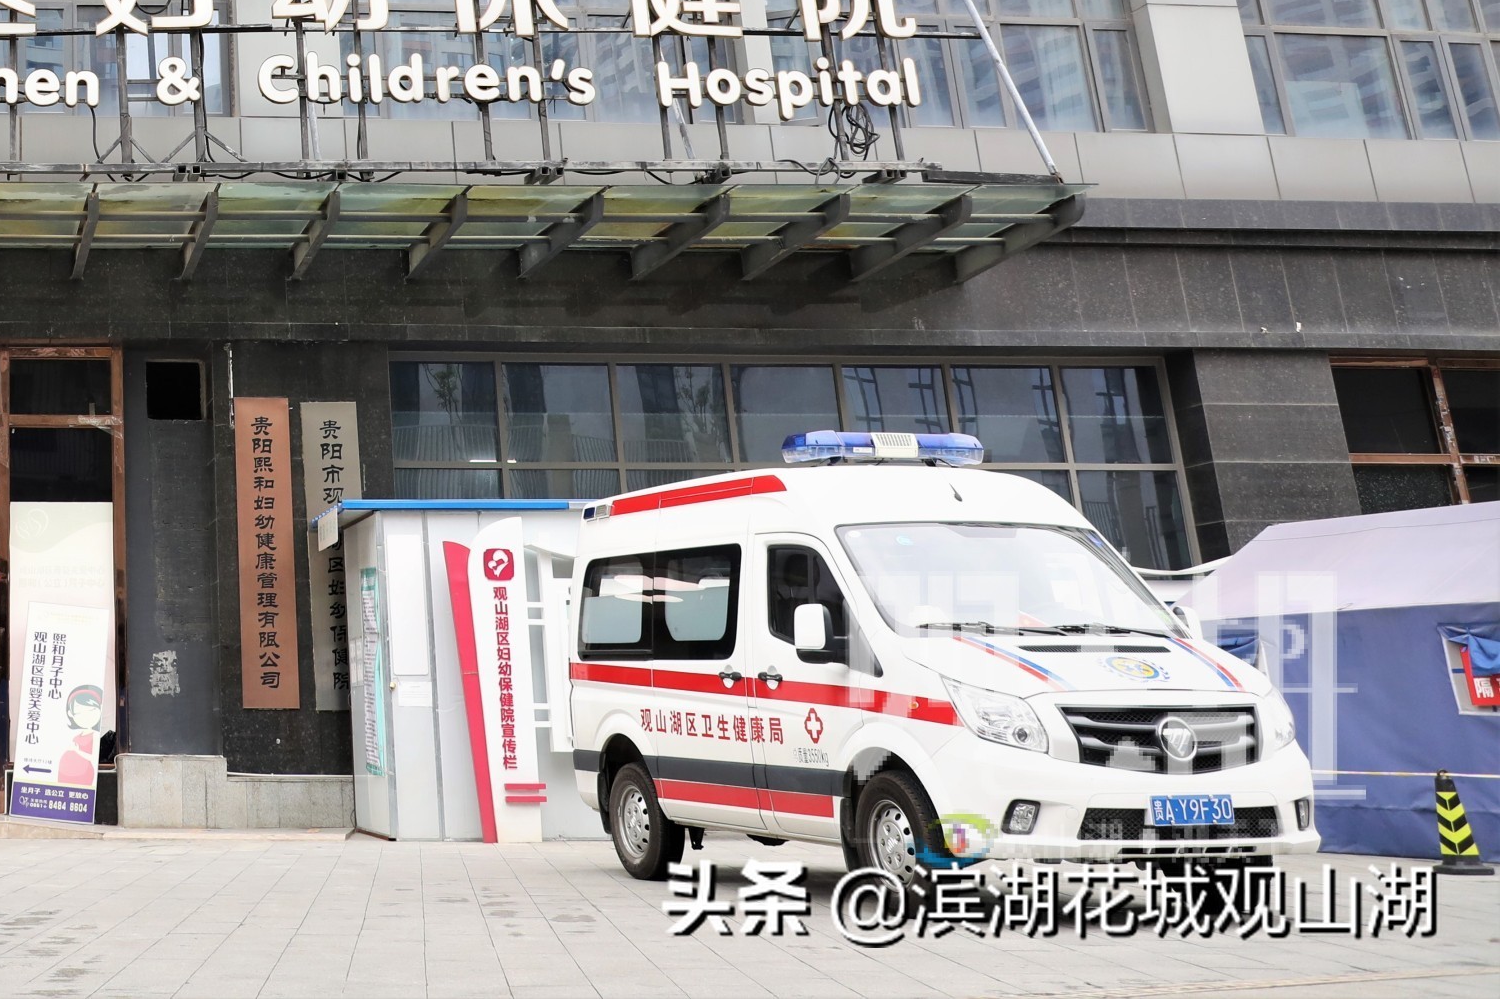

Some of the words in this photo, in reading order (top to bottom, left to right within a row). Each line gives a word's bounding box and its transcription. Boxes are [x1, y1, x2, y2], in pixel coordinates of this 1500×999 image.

[156, 56, 201, 106] &
[257, 51, 596, 106] Children's
[658, 56, 921, 121] Hospital
[250, 415, 281, 690] 贵阳熙和妇幼健康管理有限公司
[319, 419, 350, 691] 贵阳市观区妇幼保健院
[24, 631, 48, 745] 观山湖区母婴关爱中心
[47, 633, 67, 700] 熙和月子中心
[493, 586, 518, 770] 观山湖区妇幼保健院宣传栏
[1473, 677, 1500, 698] 隔
[639, 708, 784, 745] 观山湖区卫生健康局
[48, 800, 67, 811] 8484
